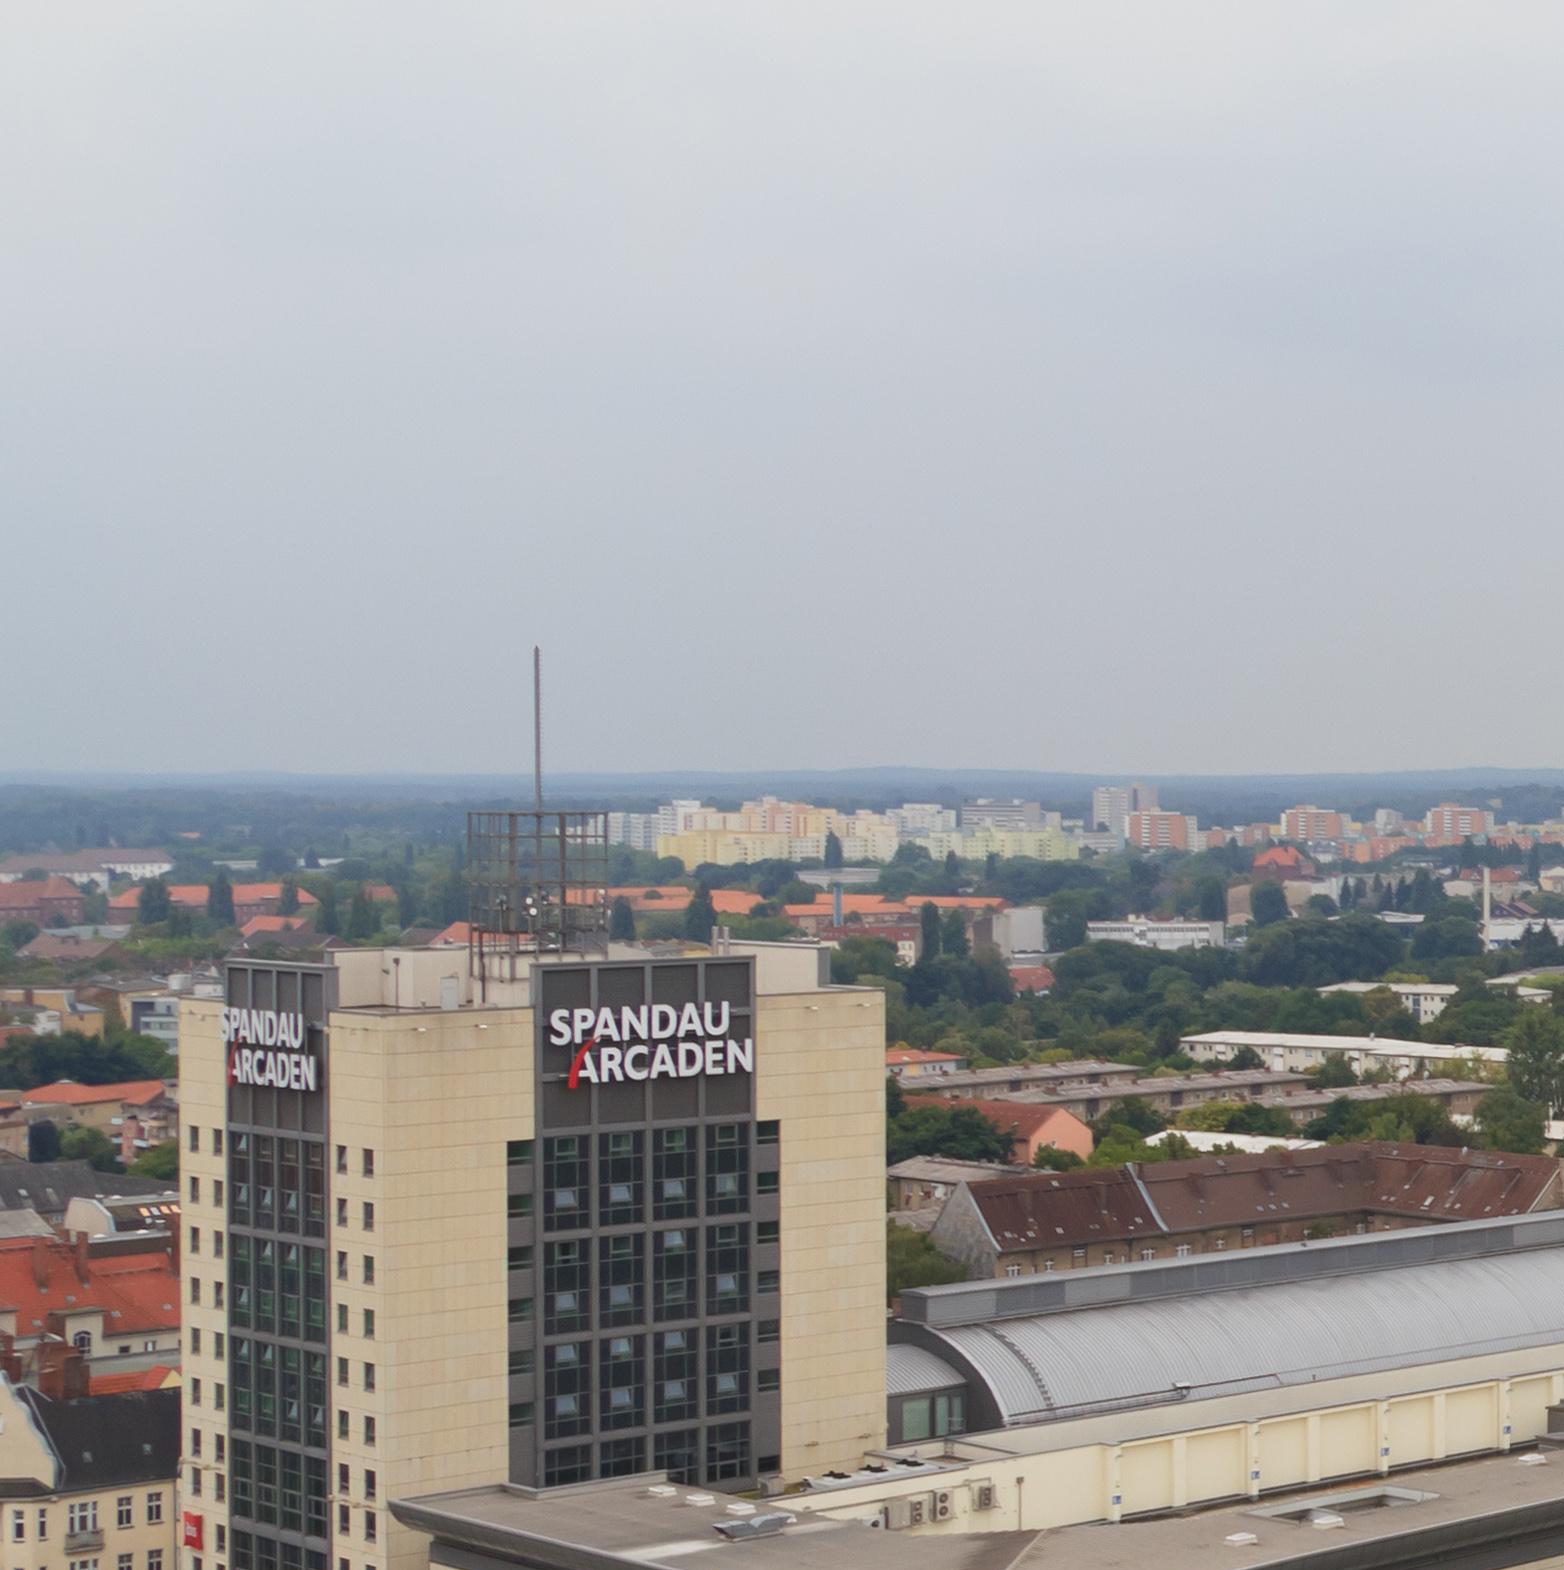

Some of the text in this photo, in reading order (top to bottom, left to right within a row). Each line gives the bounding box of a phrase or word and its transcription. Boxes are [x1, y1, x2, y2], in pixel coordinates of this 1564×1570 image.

[220, 1006, 303, 1049] SPANDAU
[549, 1001, 730, 1046] SPANDAU
[227, 1044, 317, 1092] ARCADEN
[568, 1038, 754, 1090] ARCADEN
